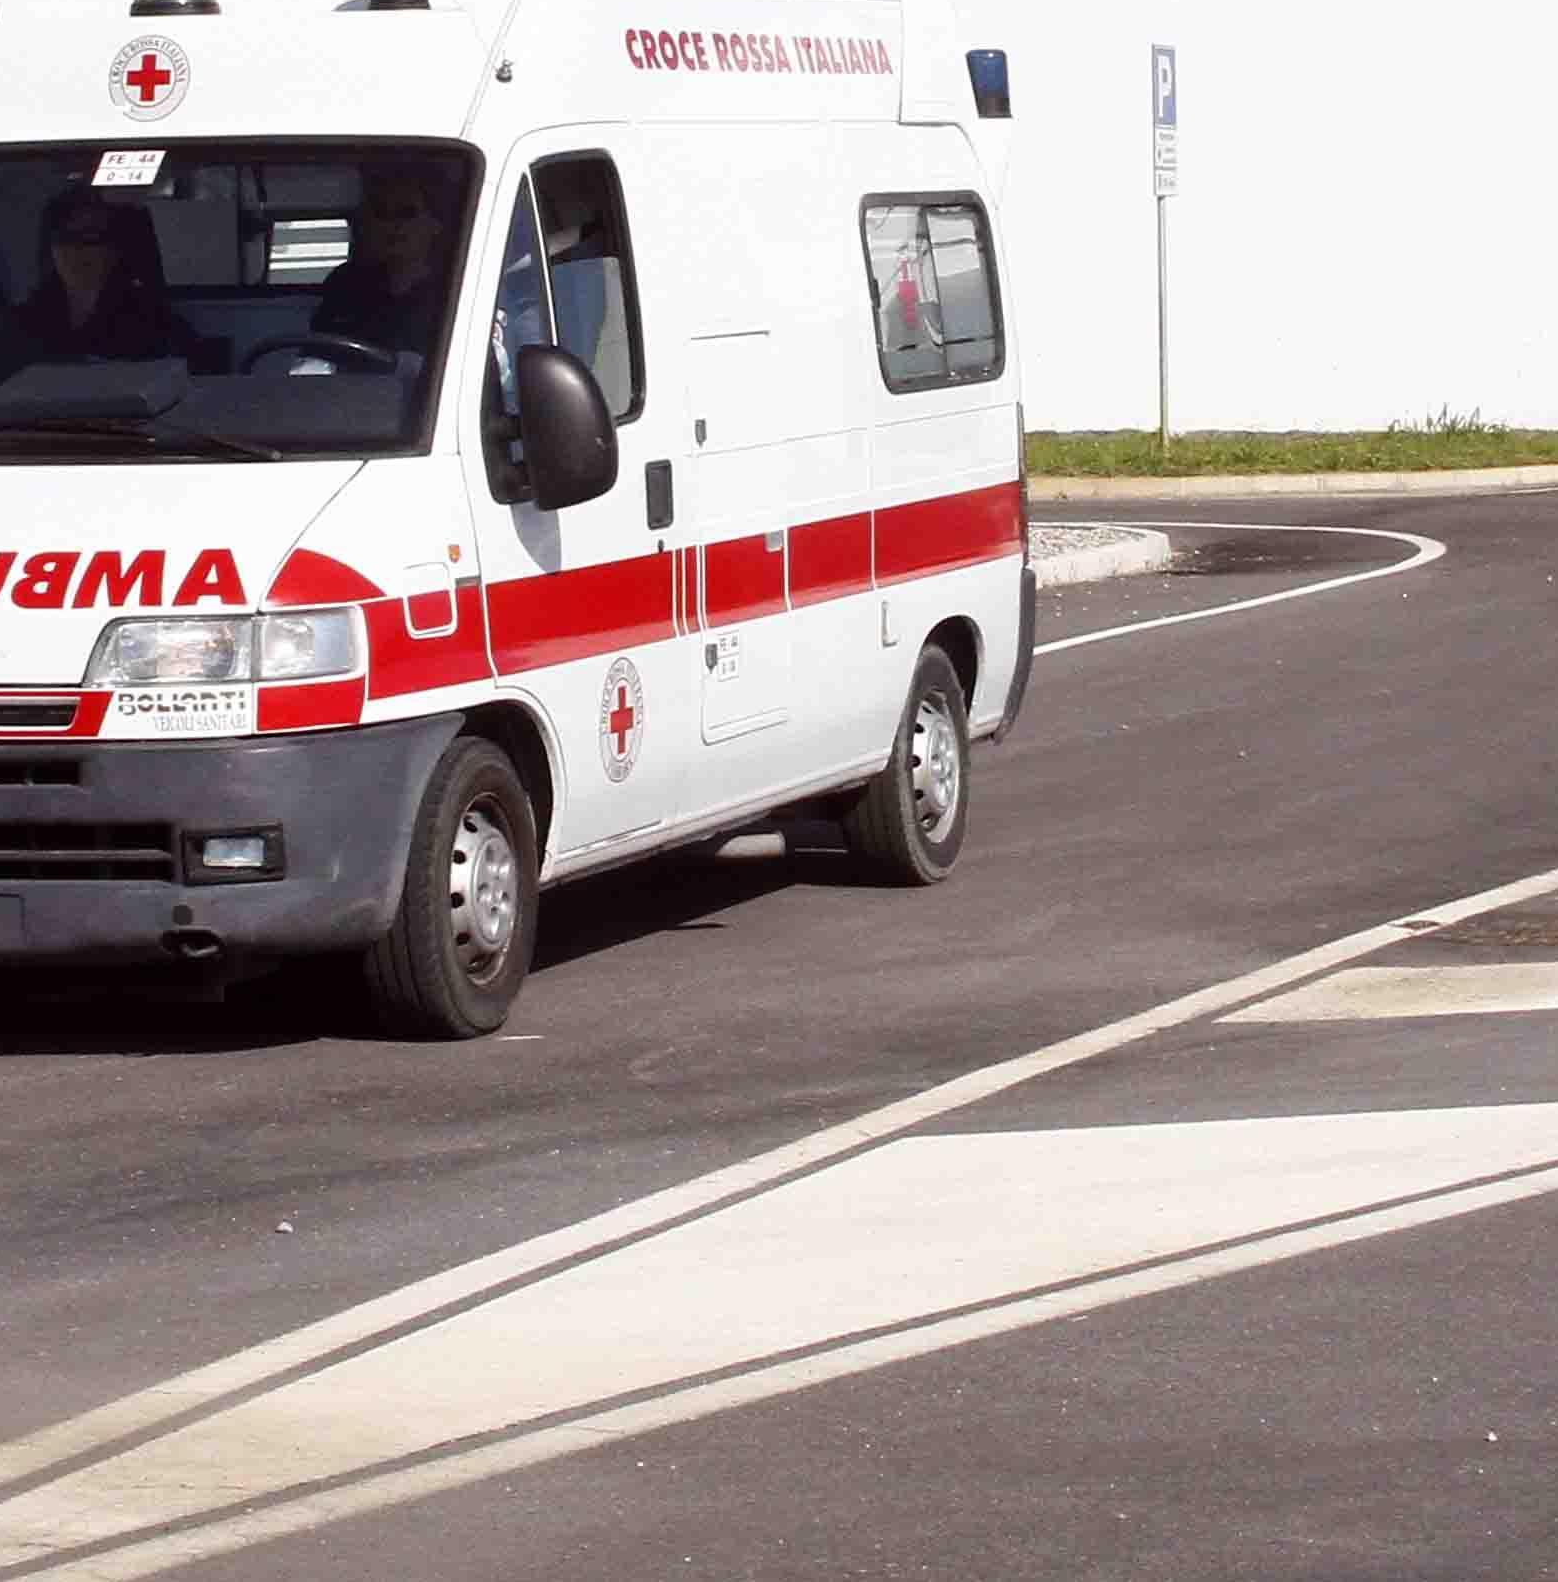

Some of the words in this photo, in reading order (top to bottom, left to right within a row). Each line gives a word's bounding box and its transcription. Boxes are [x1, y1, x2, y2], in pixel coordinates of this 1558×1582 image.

[624, 28, 709, 71] CROCE
[712, 32, 792, 73] ROSSA
[793, 36, 893, 74] ITALIANA
